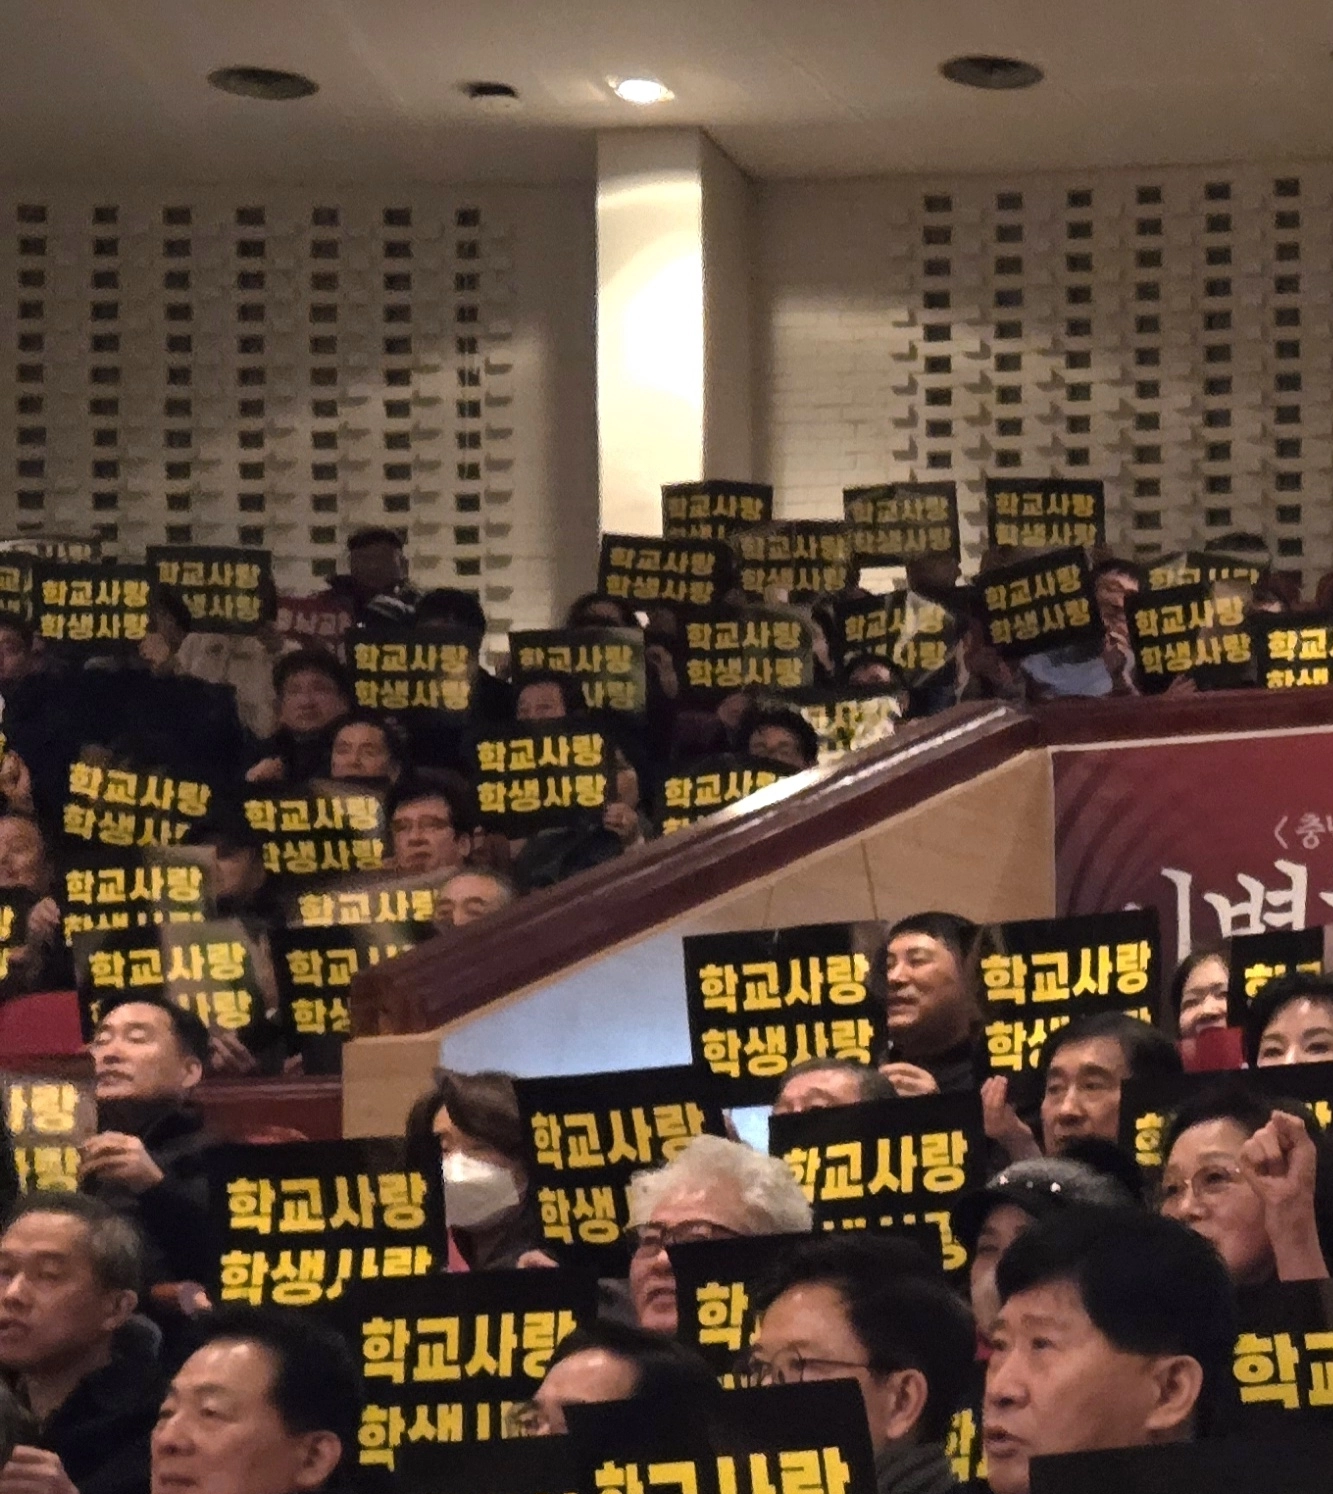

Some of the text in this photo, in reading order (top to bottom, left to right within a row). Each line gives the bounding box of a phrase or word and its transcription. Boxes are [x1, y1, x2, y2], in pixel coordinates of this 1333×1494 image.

[477, 733, 604, 773] 학교사랑
[69, 762, 211, 816] 학교사랑
[245, 798, 379, 832] 학교사랑
[66, 866, 203, 904] 학교사랑
[89, 942, 246, 988] 학교사랑
[698, 953, 870, 1013] 학교사랑
[981, 939, 1151, 1005] 학교사랑
[227, 1174, 427, 1235] 학교사랑
[538, 1186, 634, 1245] 학생
